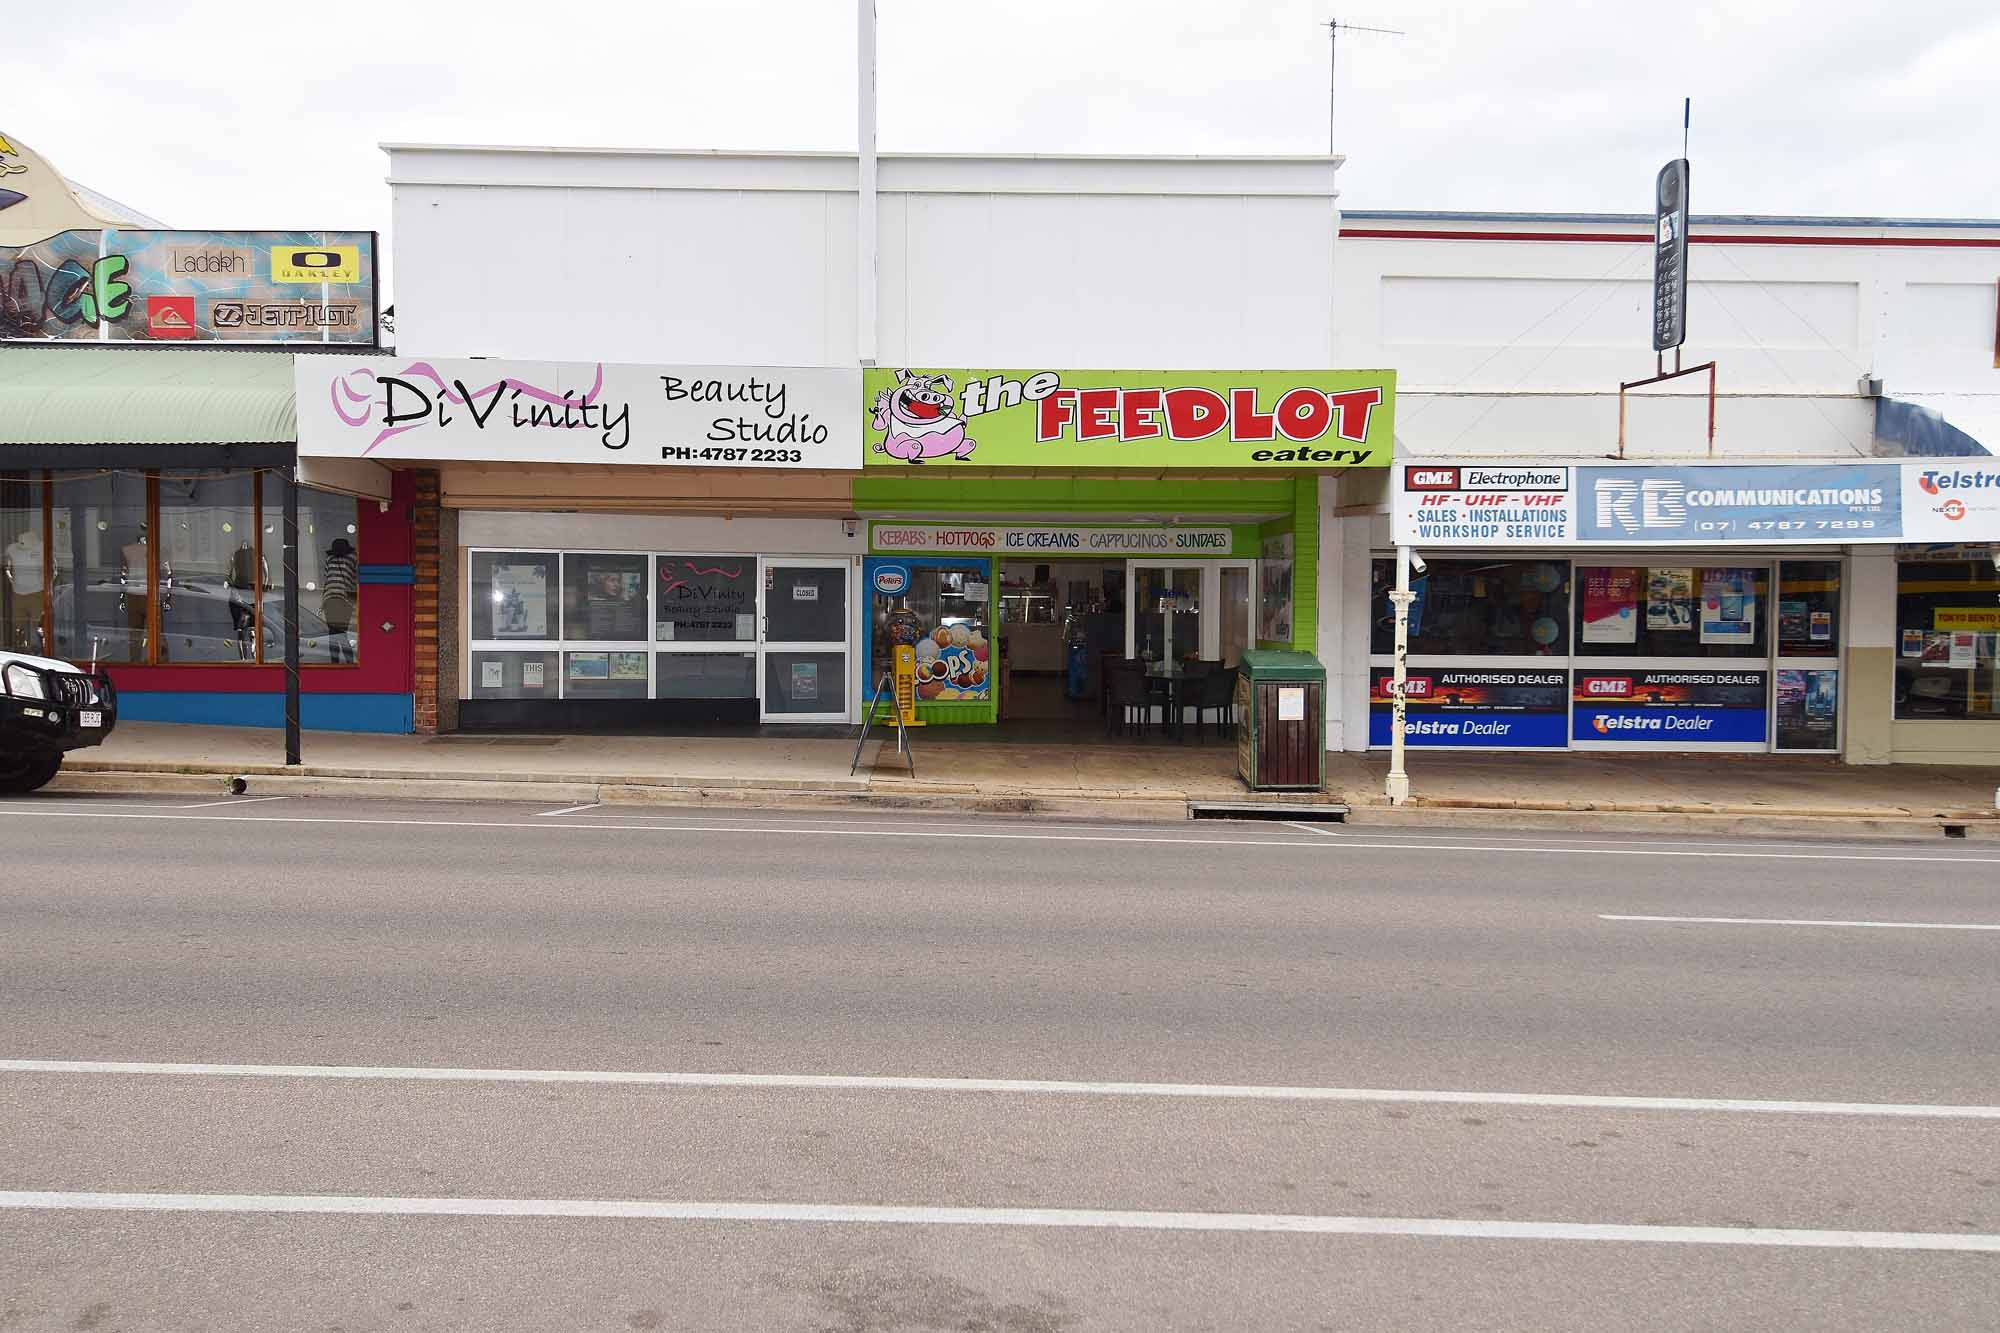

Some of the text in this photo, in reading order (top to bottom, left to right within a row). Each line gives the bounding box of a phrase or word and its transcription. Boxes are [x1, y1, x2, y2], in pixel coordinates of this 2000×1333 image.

[174, 250, 245, 273] Ladakh
[281, 269, 352, 278] OAKLEY
[0, 254, 133, 330] AGE
[245, 304, 356, 326] JETPILOT
[660, 375, 786, 419] Beauty
[960, 371, 1060, 417] the
[376, 376, 630, 450] DiVinity
[1036, 386, 1383, 443] FEEDLOT
[706, 413, 828, 445] Studio
[661, 447, 802, 463] PH:4787 2233
[1251, 446, 1373, 465] eatery
[1413, 471, 1561, 487] GME Electrophone
[1686, 488, 1882, 507] COMMUNICATIONS
[1417, 509, 1568, 522] SALES INSTALLATIONS
[1419, 525, 1565, 538] WORKSHOP SERVICE
[1694, 519, 1875, 532] (07) 4787 7299
[879, 530, 1226, 549] KEBABS HOTDOGS ICE CREAMS CAPPUCINOS SUNDAES
[1441, 674, 1564, 684] AUTHORISED DEALER
[1588, 680, 1627, 693] GME
[1644, 675, 1760, 684] AUTHORISED DEALER
[1403, 720, 1512, 735] elstra Dealer
[1594, 714, 1713, 730] Telstra Dealer
